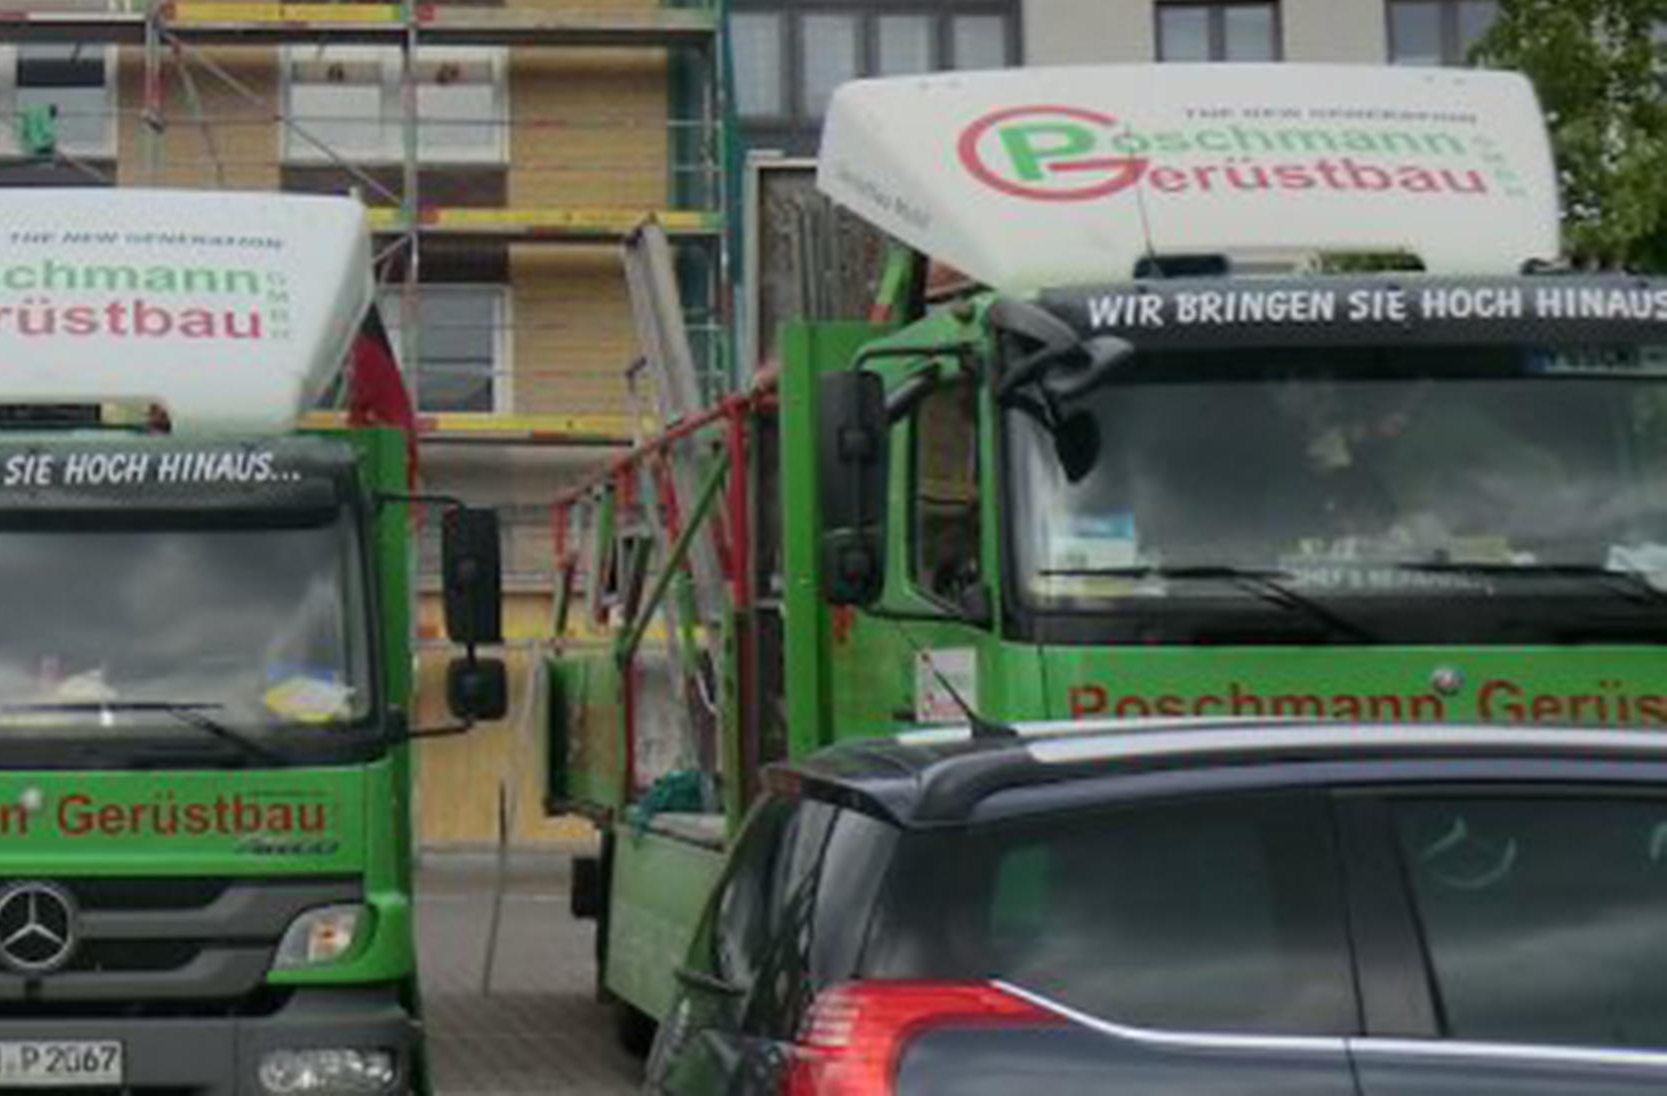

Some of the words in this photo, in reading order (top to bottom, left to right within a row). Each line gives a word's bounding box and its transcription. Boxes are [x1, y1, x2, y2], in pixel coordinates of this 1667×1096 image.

[956, 104, 1488, 202] Gerüstbau
[996, 120, 1466, 182] Poschmann
[1088, 293, 1165, 328] WIR
[1176, 290, 1334, 323] BRINGEN
[1348, 288, 1408, 321] SIE
[1422, 287, 1522, 319] HOCH
[3, 452, 52, 485] SIE
[63, 451, 148, 483] HOCH
[1066, 684, 1444, 723] Poschmann
[57, 790, 327, 835] Gerüstbau
[45, 1045, 118, 1073] 2067
